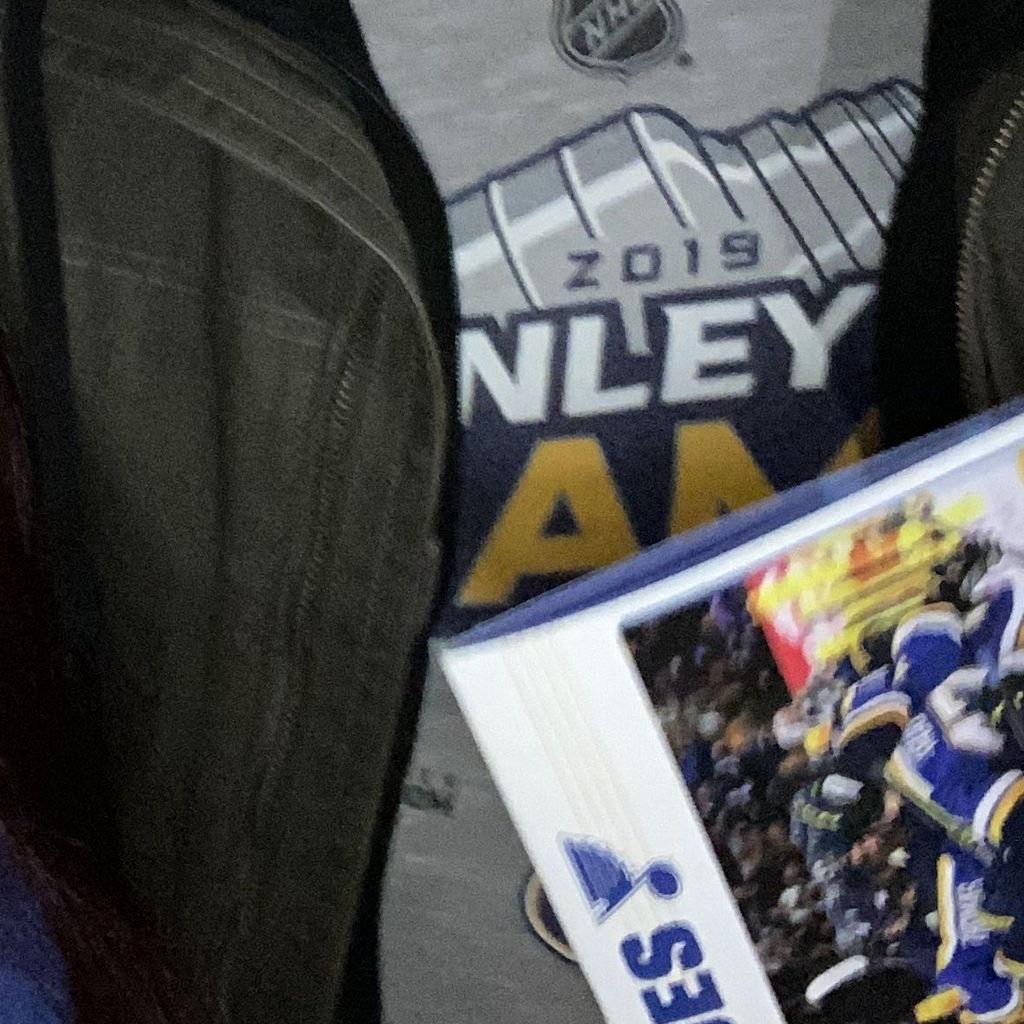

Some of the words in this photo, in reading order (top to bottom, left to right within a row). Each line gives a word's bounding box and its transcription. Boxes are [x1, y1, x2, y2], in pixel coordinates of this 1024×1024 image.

[565, 230, 760, 289] 2019
[458, 284, 876, 426] NLEY
[620, 921, 733, 1024] ES
